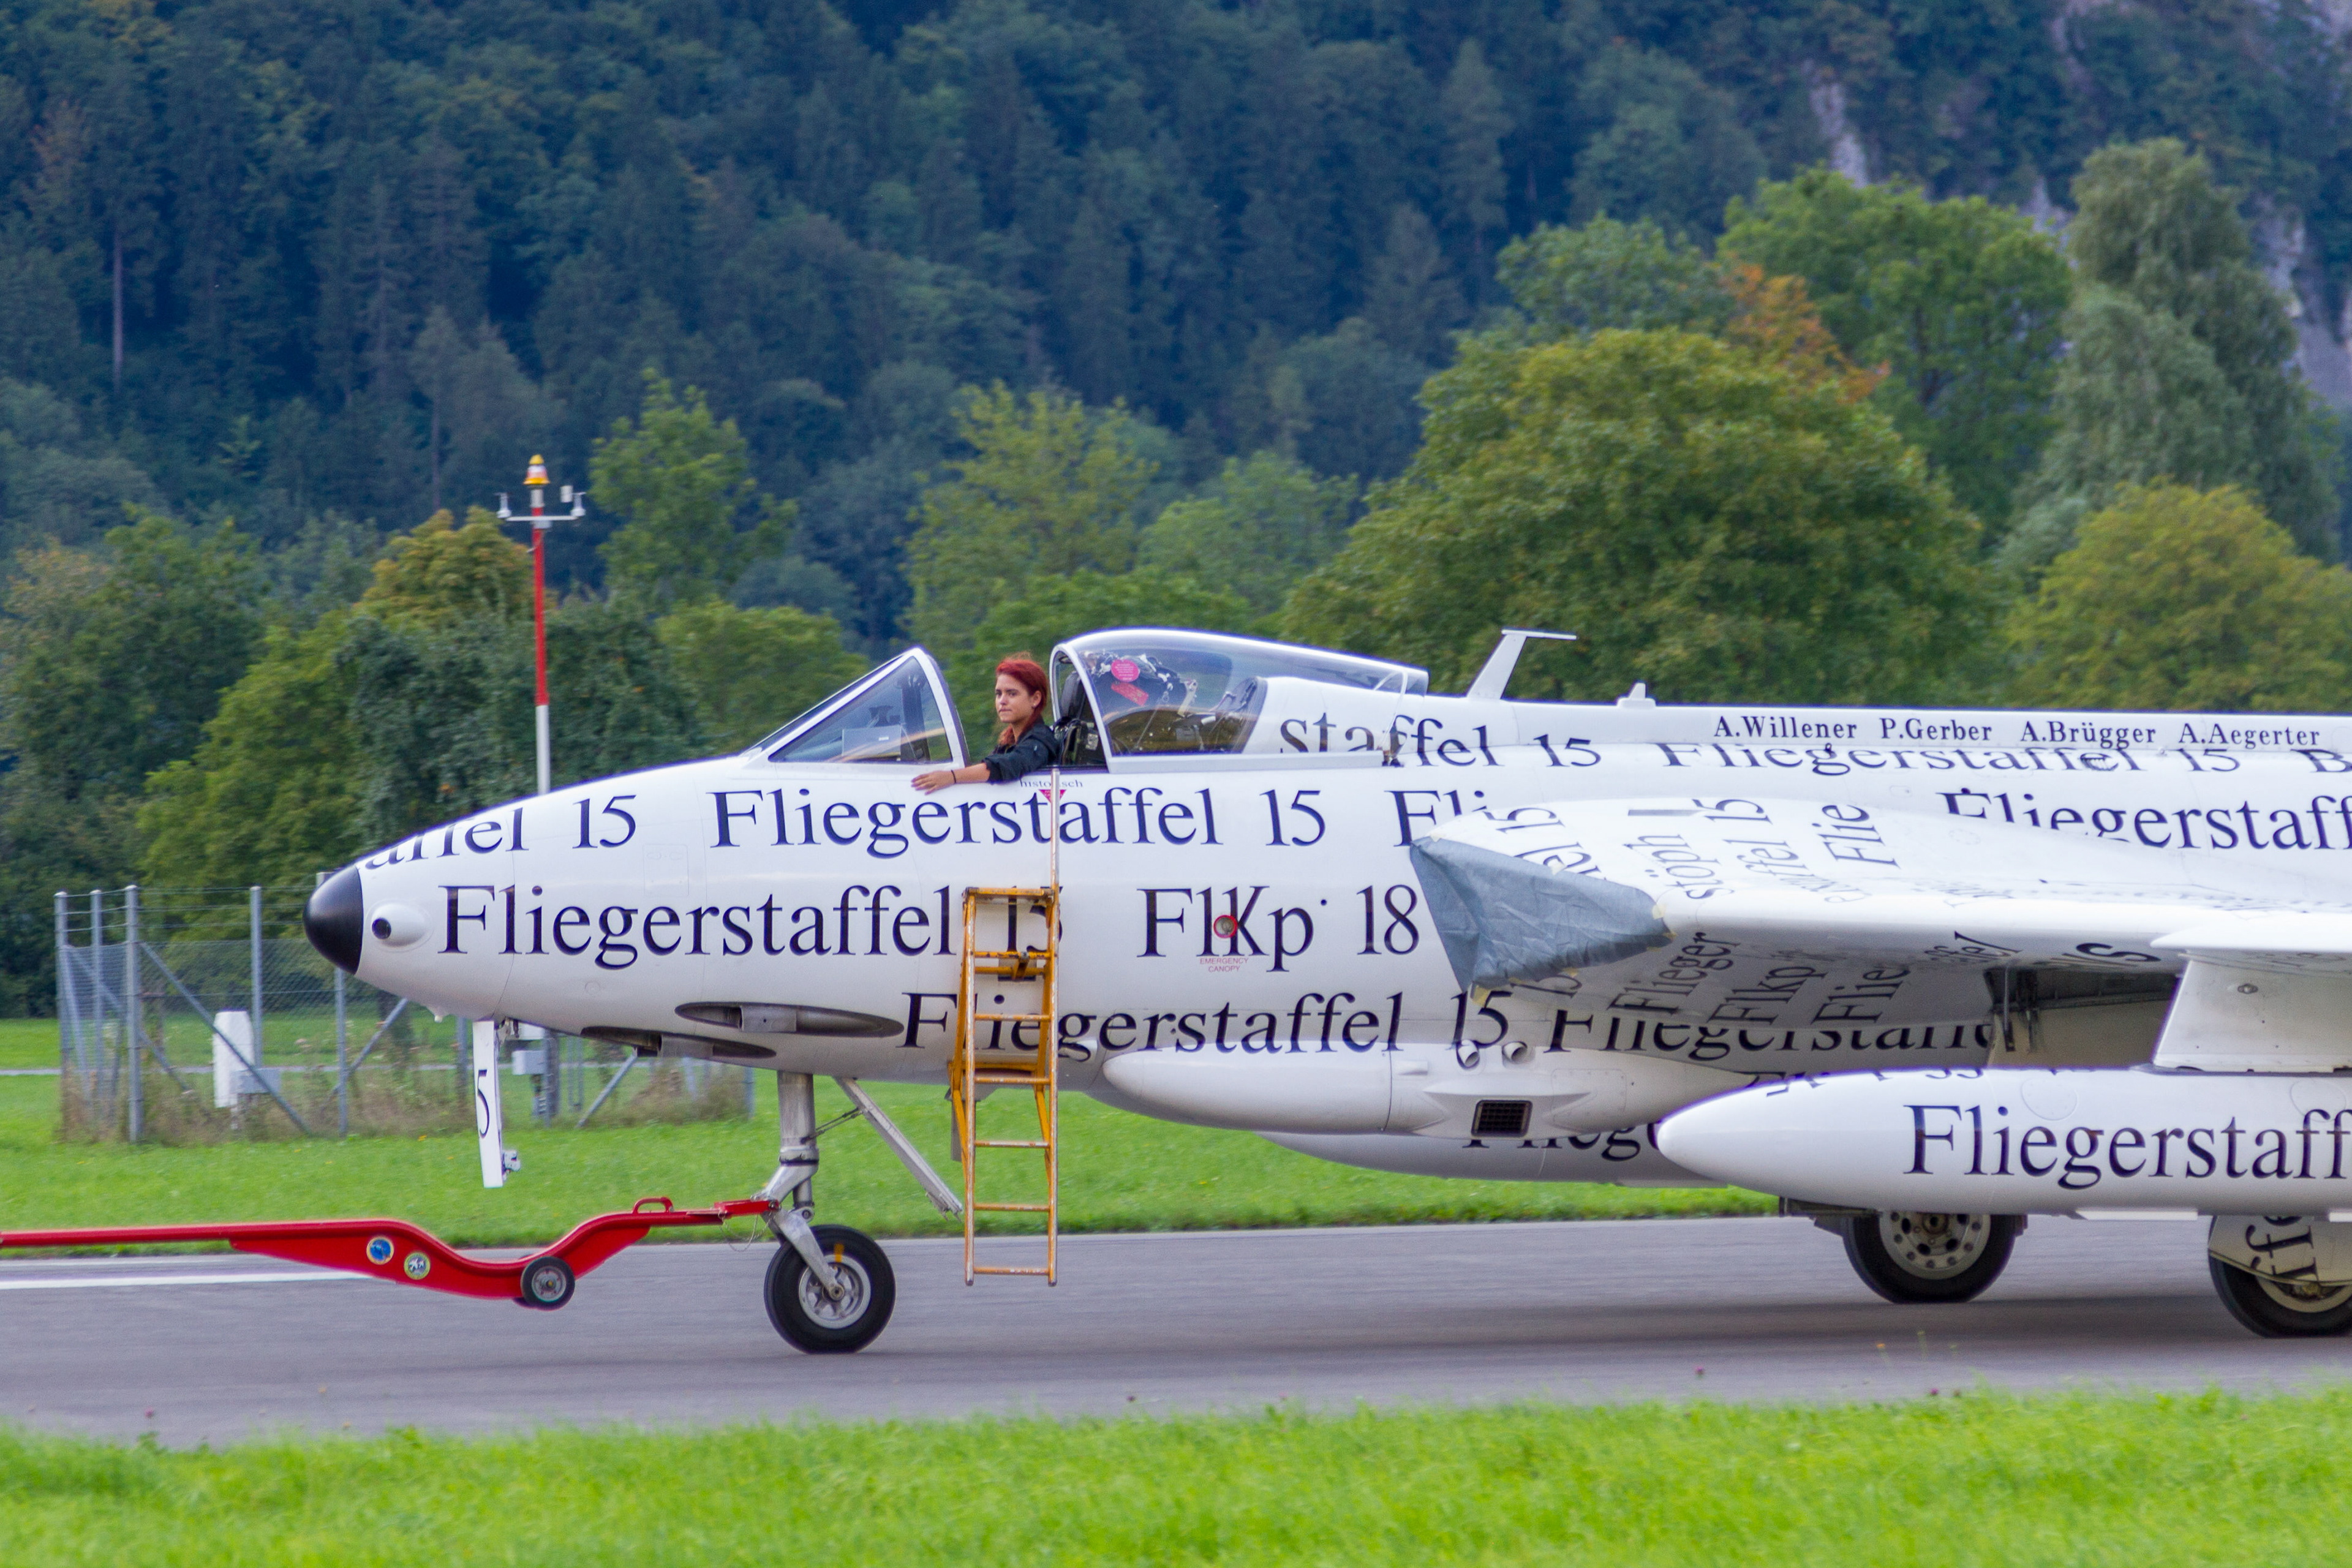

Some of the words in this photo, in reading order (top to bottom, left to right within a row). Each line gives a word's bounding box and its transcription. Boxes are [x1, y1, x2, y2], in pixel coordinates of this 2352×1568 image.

[1714, 715, 1857, 739] A.Willener
[1880, 717, 1992, 741] P.Gerber
[2020, 720, 2156, 748] A.Brügger
[2178, 723, 2320, 750] A.Aegerter
[1533, 734, 1602, 767] 15
[1654, 742, 2148, 776] Fliegerstaffel
[2174, 748, 2241, 772] 15
[1019, 779, 1084, 788] histosch
[572, 794, 637, 850] 15
[706, 786, 1224, 859] Fliegerstaffel
[1259, 788, 1326, 847] 15
[437, 884, 957, 971] Fliegerstaffel
[1356, 884, 1420, 956] 18
